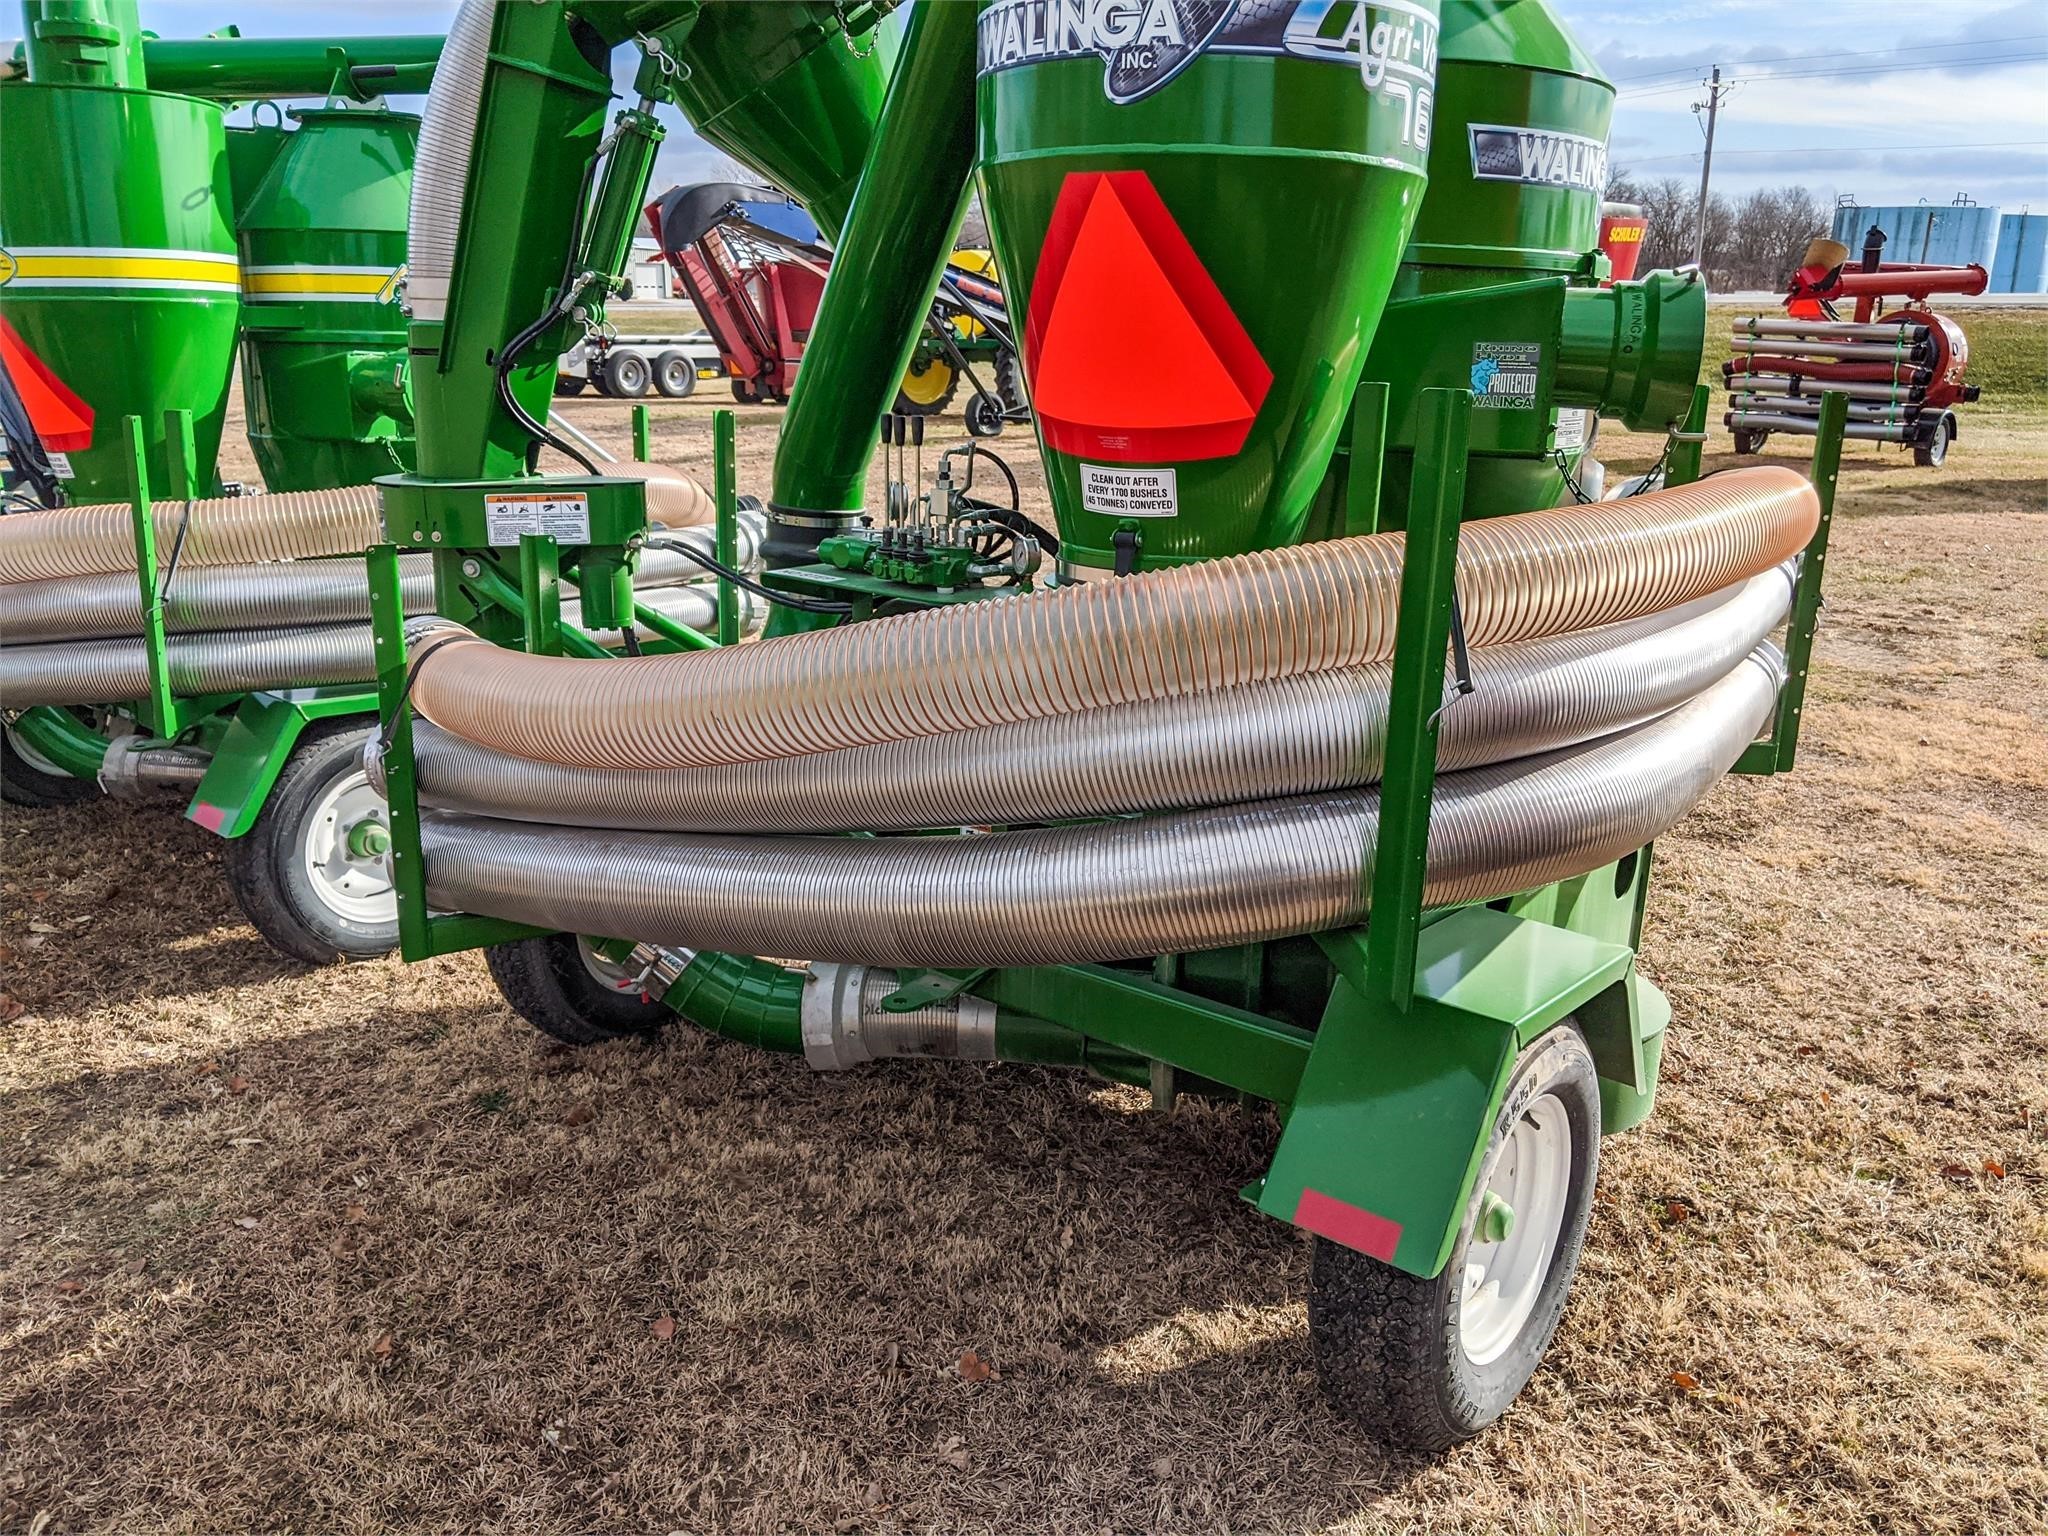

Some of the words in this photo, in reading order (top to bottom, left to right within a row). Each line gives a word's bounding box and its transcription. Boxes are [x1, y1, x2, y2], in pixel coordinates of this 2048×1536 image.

[982, 0, 1181, 68] WALINGA
[1121, 52, 1157, 70] INC.
[1629, 292, 1643, 344] WALINGA
[1487, 373, 1537, 394] PROTECTED
[1472, 395, 1534, 410] WALINGA
[1091, 473, 1114, 485] CLEAN
[1115, 475, 1131, 486] OUT
[1132, 477, 1159, 487] AFTER
[1087, 484, 1109, 495] EVERY
[1111, 487, 1128, 497] 1700
[1130, 488, 1168, 498] BUSHELS
[1085, 496, 1095, 505] (45
[1096, 497, 1128, 510] TONNES)
[1129, 500, 1173, 510] CONVEYED
